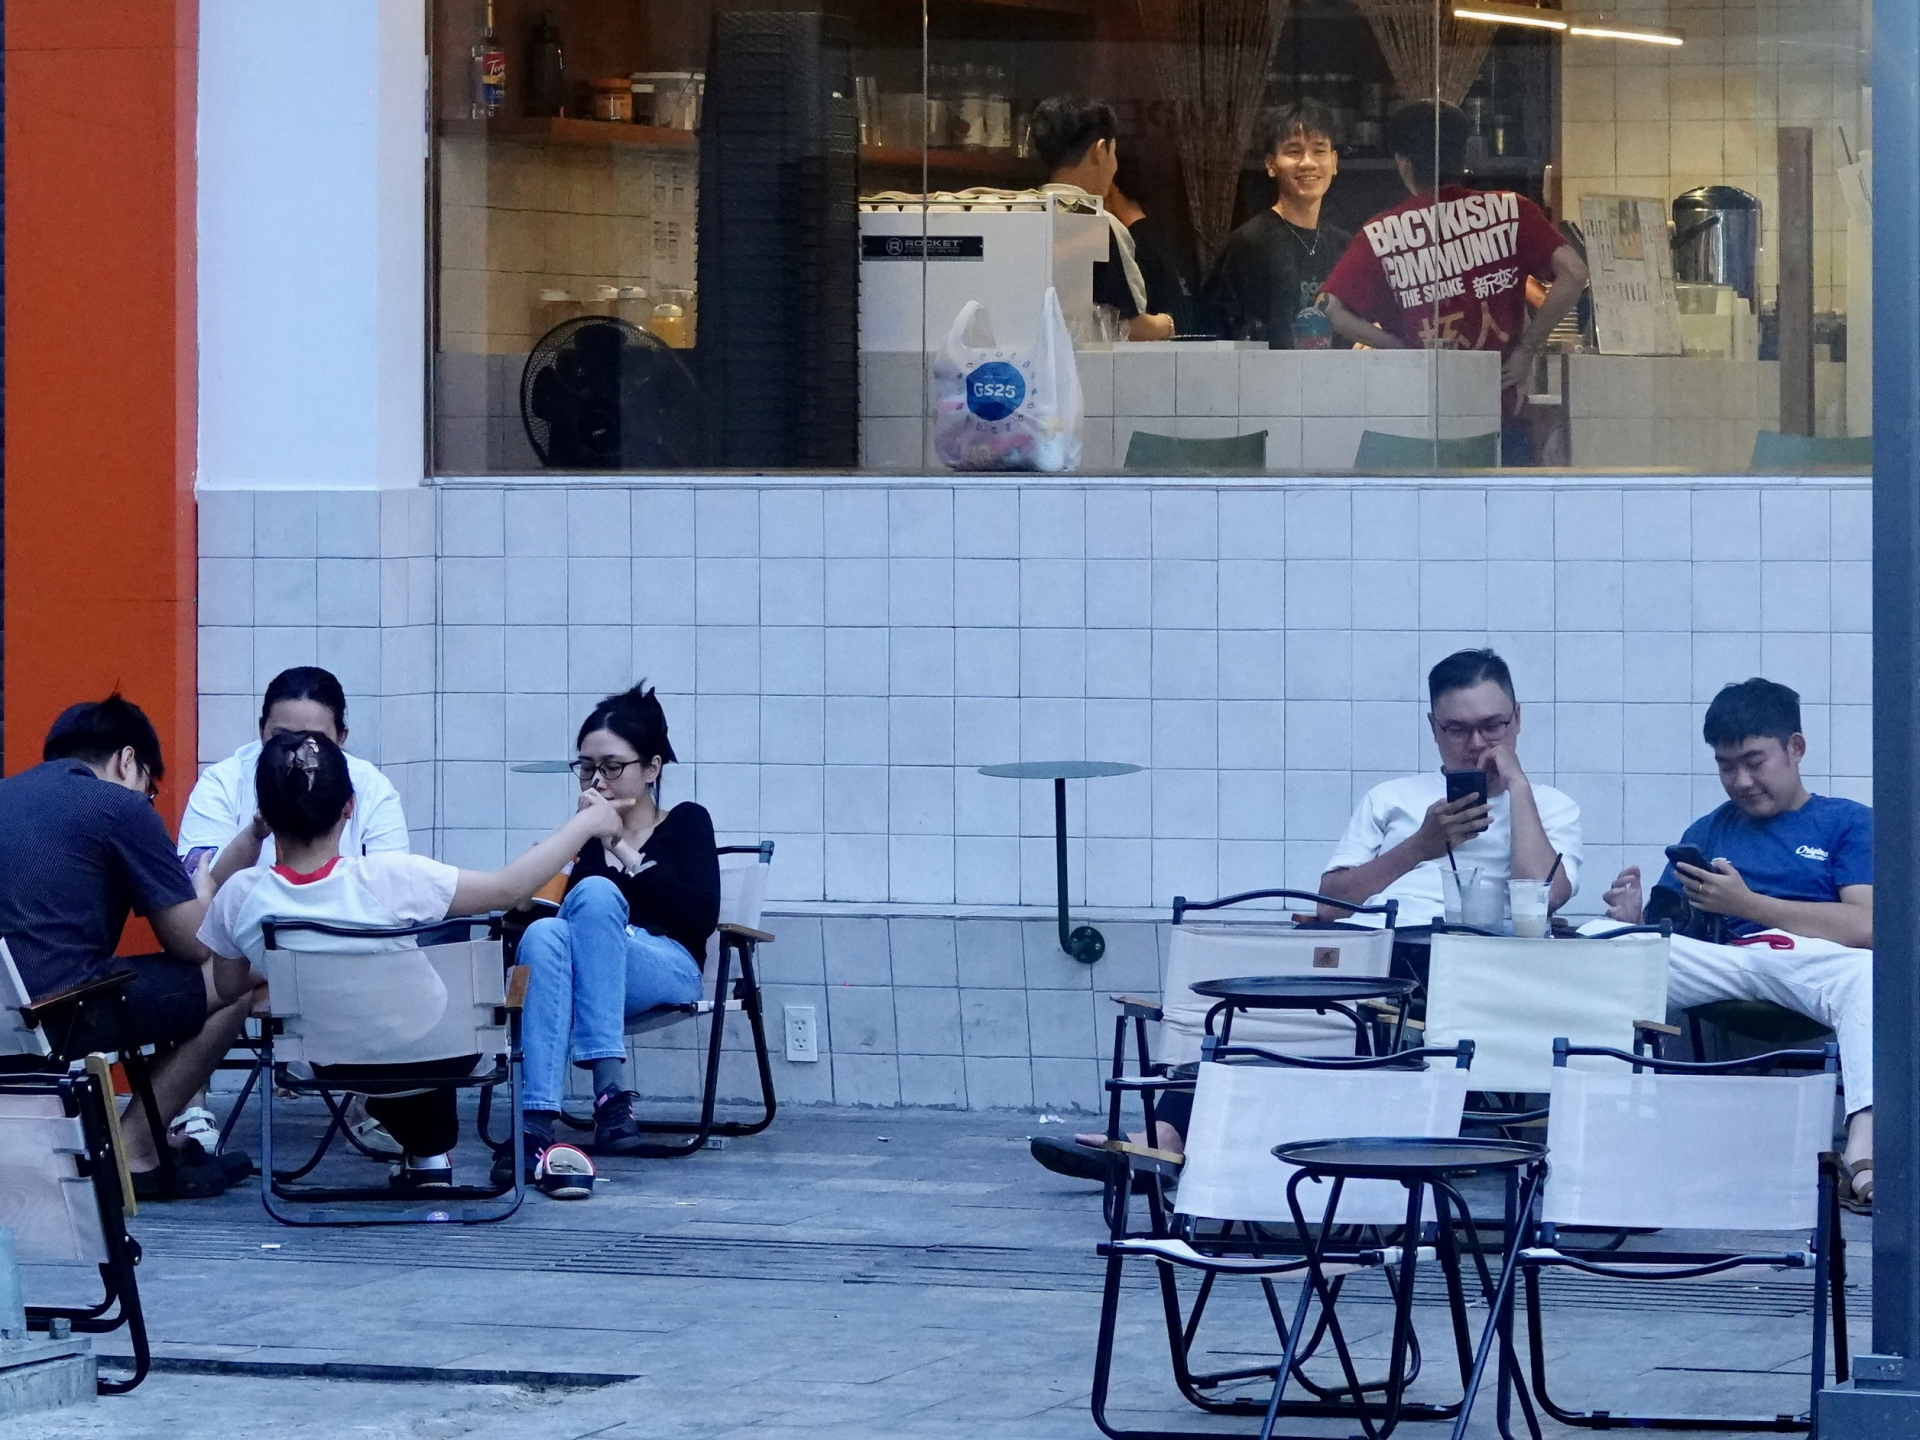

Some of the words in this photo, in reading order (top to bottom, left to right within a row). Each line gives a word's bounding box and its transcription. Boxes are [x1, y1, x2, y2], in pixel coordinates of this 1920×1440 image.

[1363, 192, 1519, 257] BACYKISM
[1381, 222, 1519, 289] COMMUNITY
[1400, 286, 1423, 308] THE
[973, 382, 1016, 399] GS25
